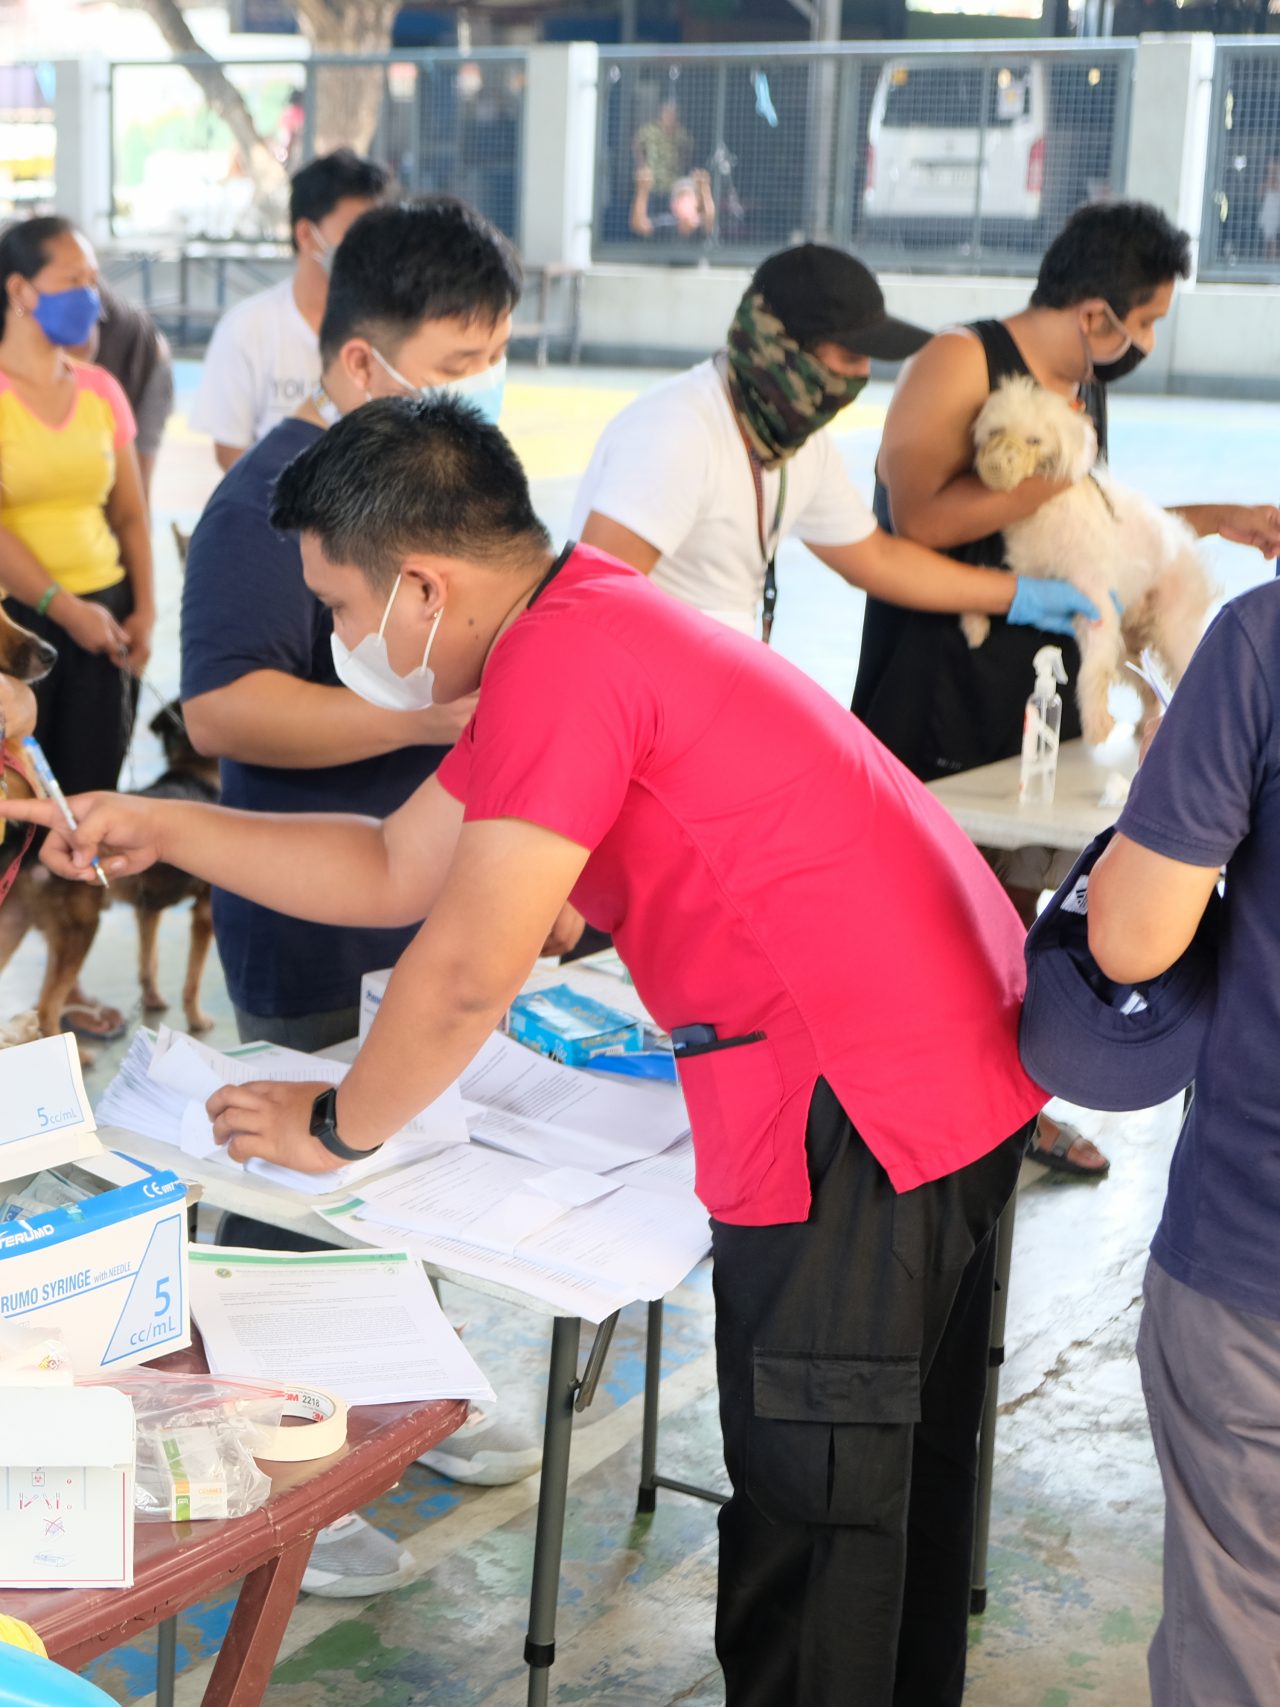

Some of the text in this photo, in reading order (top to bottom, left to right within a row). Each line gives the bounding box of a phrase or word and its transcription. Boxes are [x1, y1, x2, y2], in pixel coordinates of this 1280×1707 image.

[37, 1107, 77, 1127] 5 cc/mL
[42, 1269, 91, 1301] SYRINGE
[93, 1271, 108, 1283] with
[108, 1261, 131, 1277] NEEDLE
[154, 1275, 171, 1317] 5
[130, 1316, 176, 1345] cc/mL
